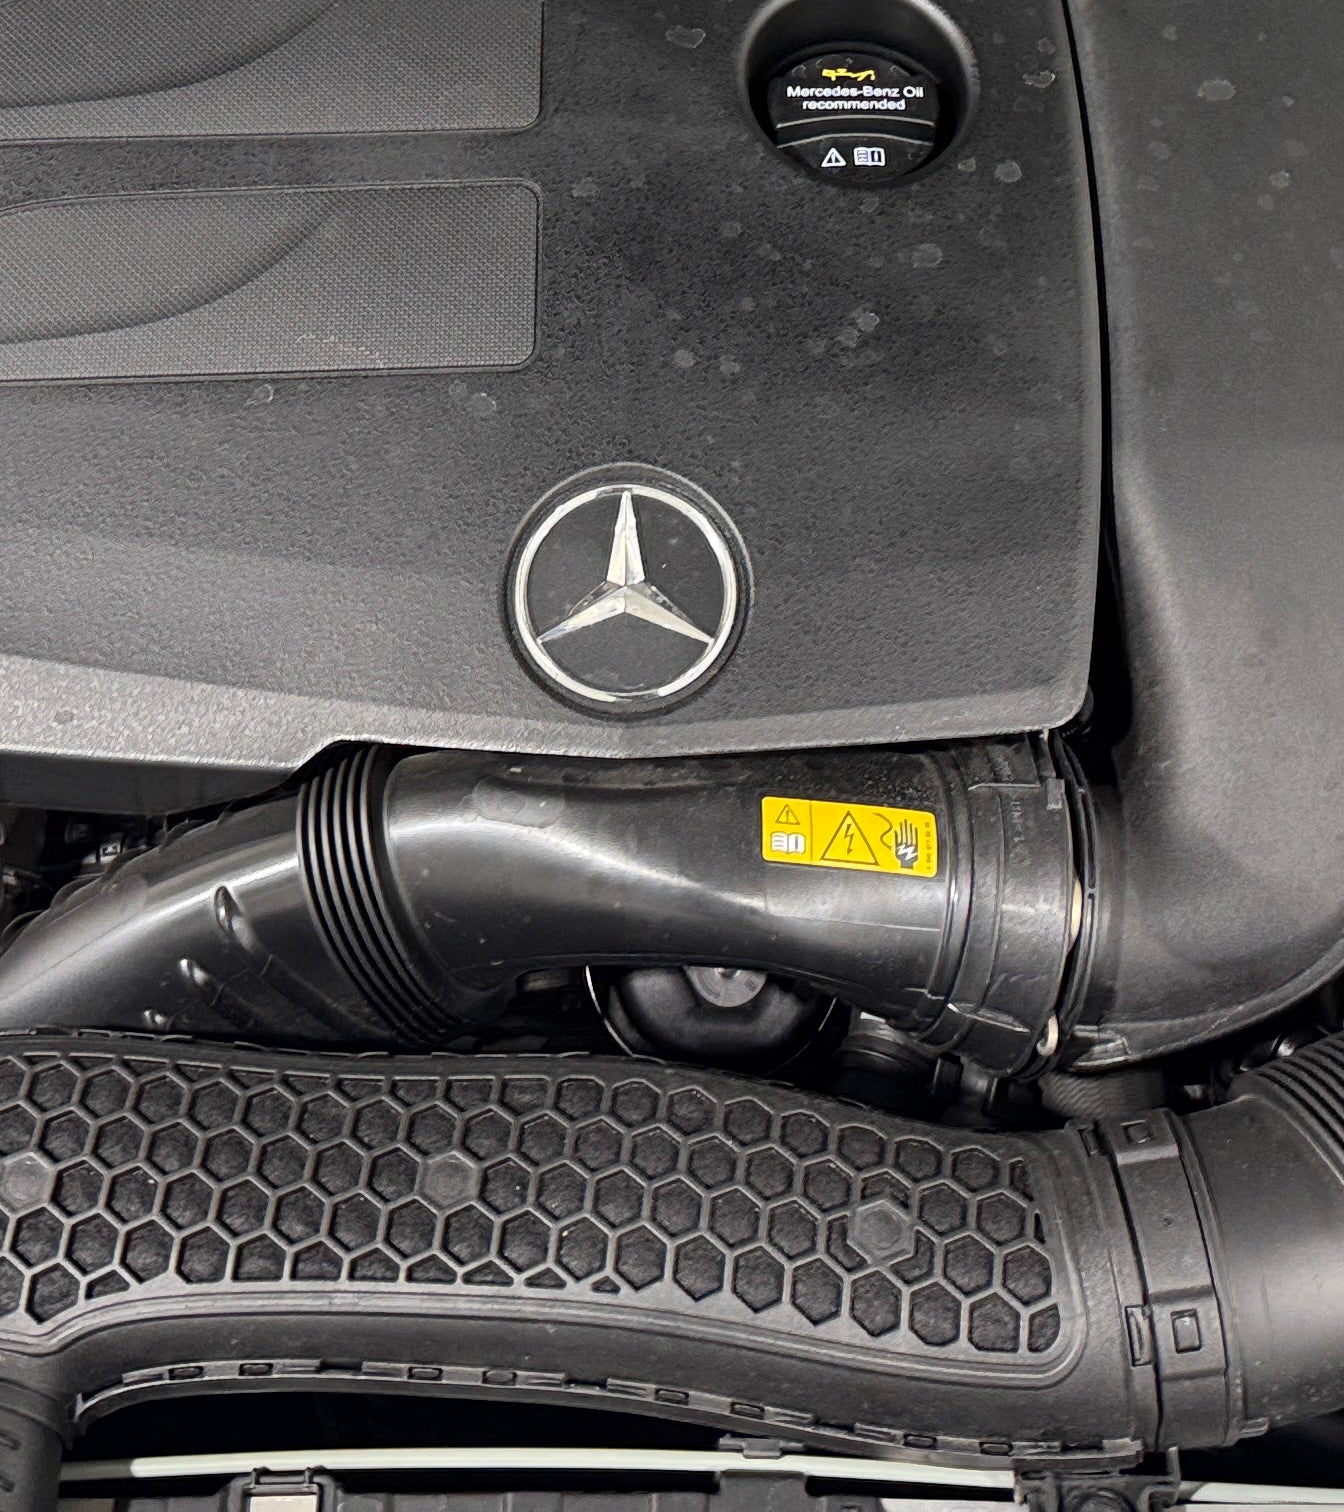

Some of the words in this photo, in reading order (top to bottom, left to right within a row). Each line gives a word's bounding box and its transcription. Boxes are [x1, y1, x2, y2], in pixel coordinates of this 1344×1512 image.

[786, 85, 900, 98] Mercedes-Benz
[902, 86, 924, 98] Oil
[802, 99, 906, 110] recommended
